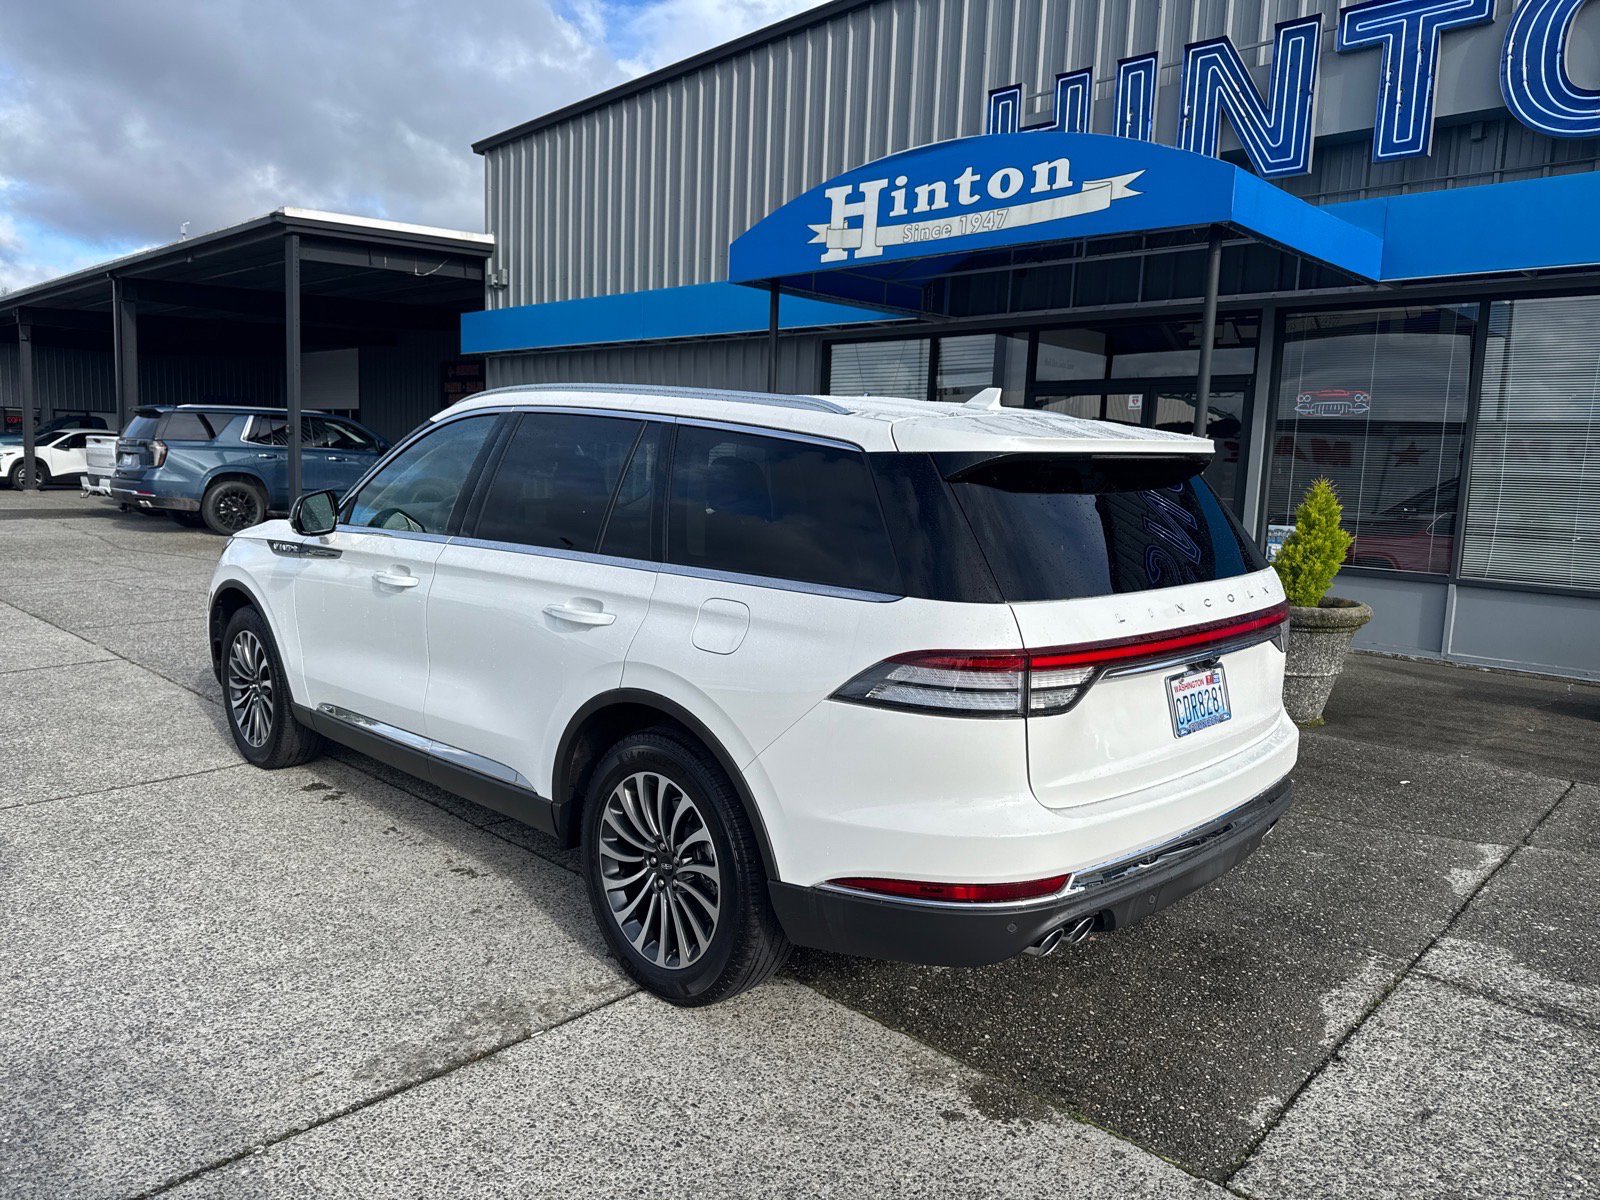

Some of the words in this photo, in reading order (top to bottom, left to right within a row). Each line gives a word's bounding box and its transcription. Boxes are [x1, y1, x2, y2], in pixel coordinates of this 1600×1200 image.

[820, 157, 1073, 263] Hinton
[902, 221, 952, 243] Since
[959, 208, 1010, 235] 1947
[1115, 586, 1270, 623] LINCOLN
[1174, 679, 1205, 693] WASHINGTON
[1176, 685, 1225, 725] CDR8281
